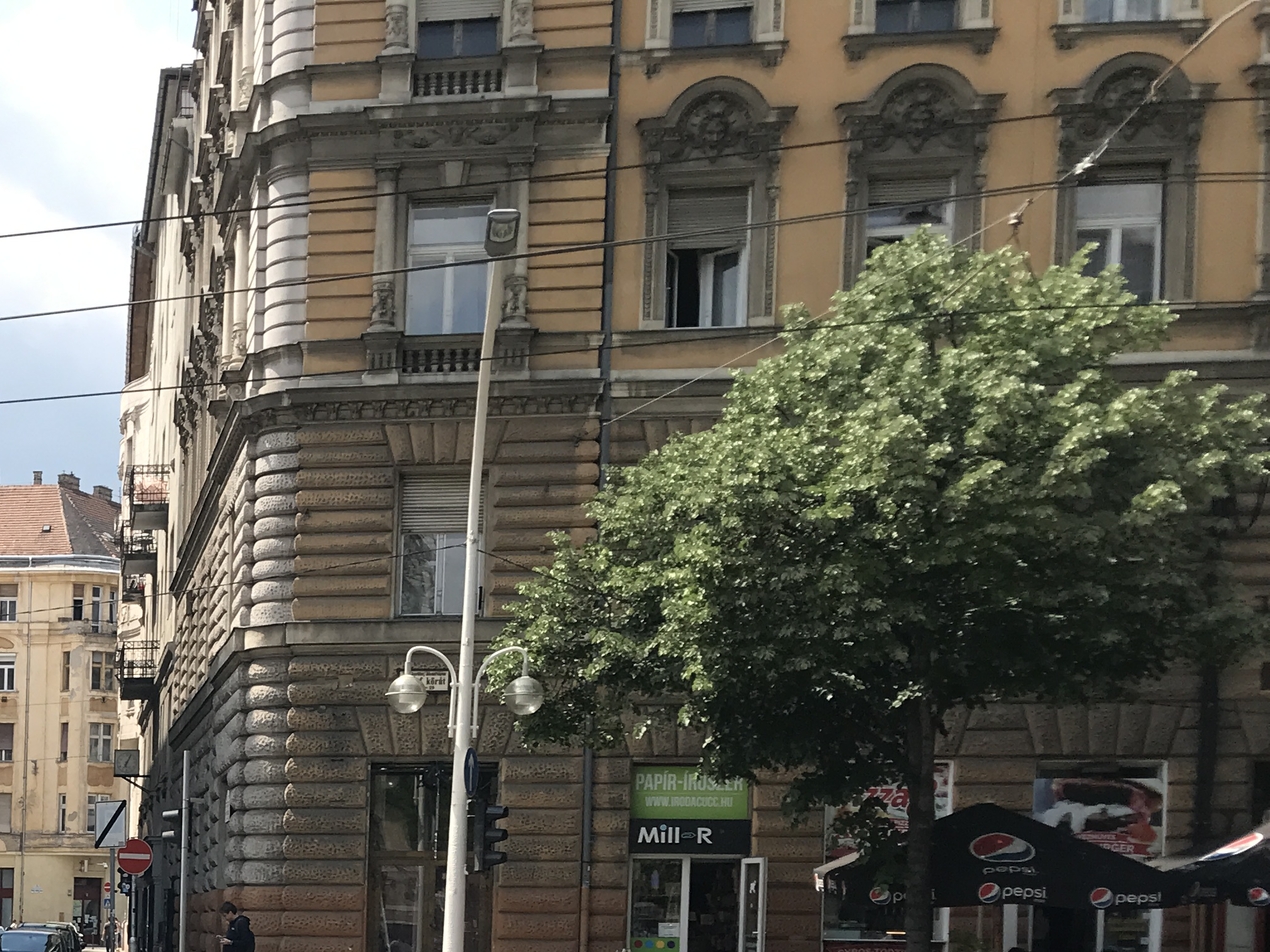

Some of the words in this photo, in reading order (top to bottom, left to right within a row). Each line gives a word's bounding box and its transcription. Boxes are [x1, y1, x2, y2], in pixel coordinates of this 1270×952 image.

[645, 796, 734, 808] WWW.IRODACUCC.HU
[982, 865, 1036, 876] pepsi
[1002, 886, 1047, 900] pepsi
[1115, 892, 1162, 905] pepsi
